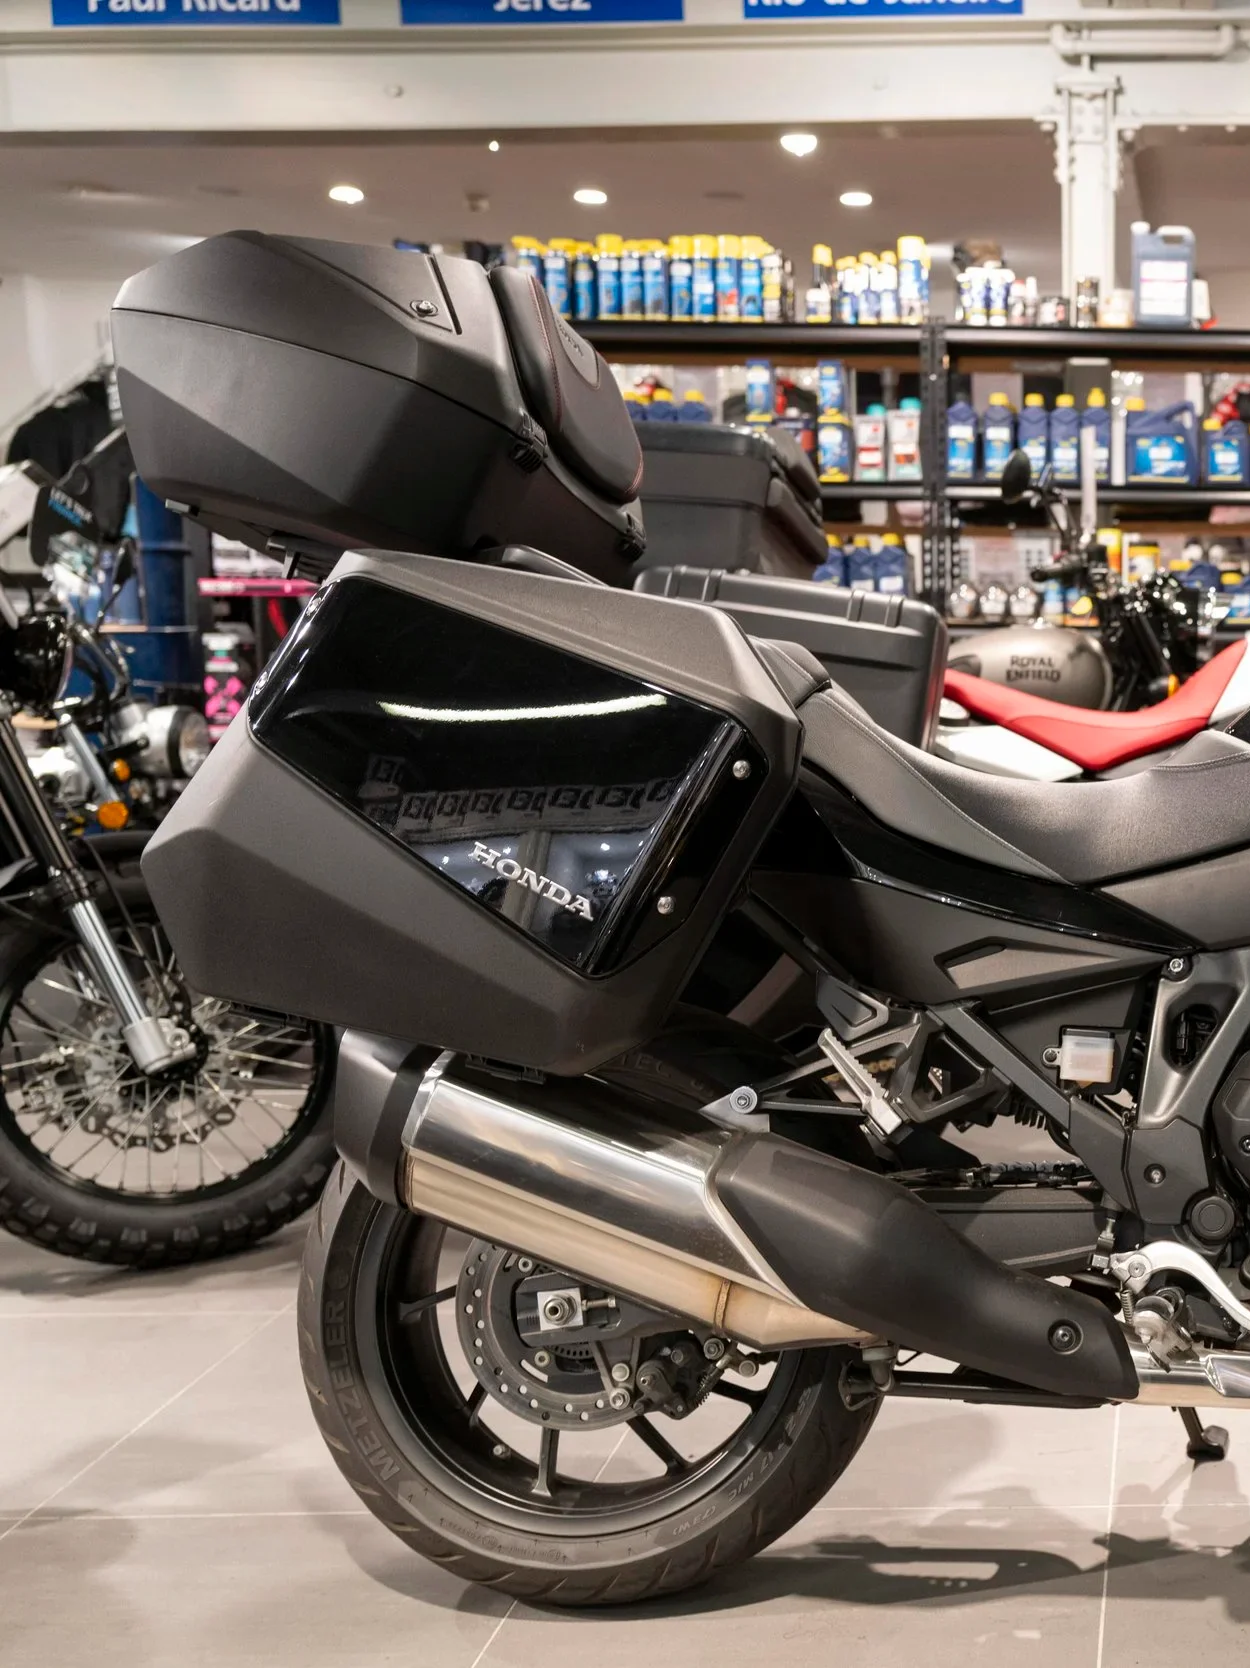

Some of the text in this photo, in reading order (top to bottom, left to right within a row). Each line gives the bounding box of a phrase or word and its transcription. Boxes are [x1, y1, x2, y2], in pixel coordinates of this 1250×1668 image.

[1006, 669, 1061, 682] ENFIELD
[1010, 655, 1054, 668] ROYAL
[473, 841, 594, 922] HONDA
[325, 1301, 401, 1481] METZELER
